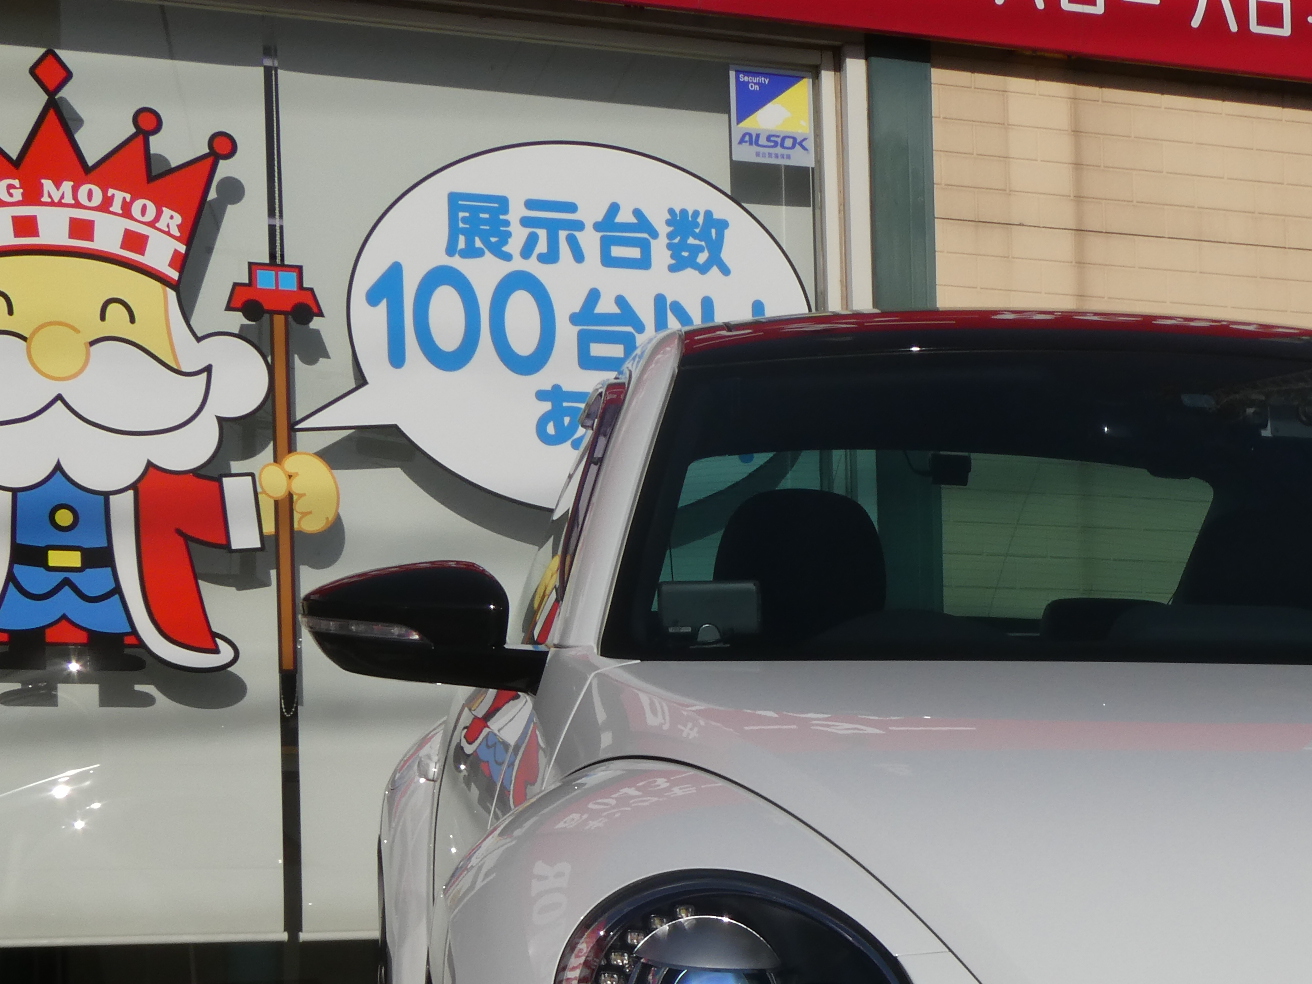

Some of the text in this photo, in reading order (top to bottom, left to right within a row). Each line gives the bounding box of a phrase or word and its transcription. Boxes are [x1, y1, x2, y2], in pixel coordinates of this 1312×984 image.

[739, 74, 769, 84] Security
[748, 83, 759, 91] On
[738, 132, 809, 151] ALSOK
[41, 179, 182, 237] MOTOR
[445, 191, 732, 277] 展示台数
[365, 260, 766, 376] 100台
